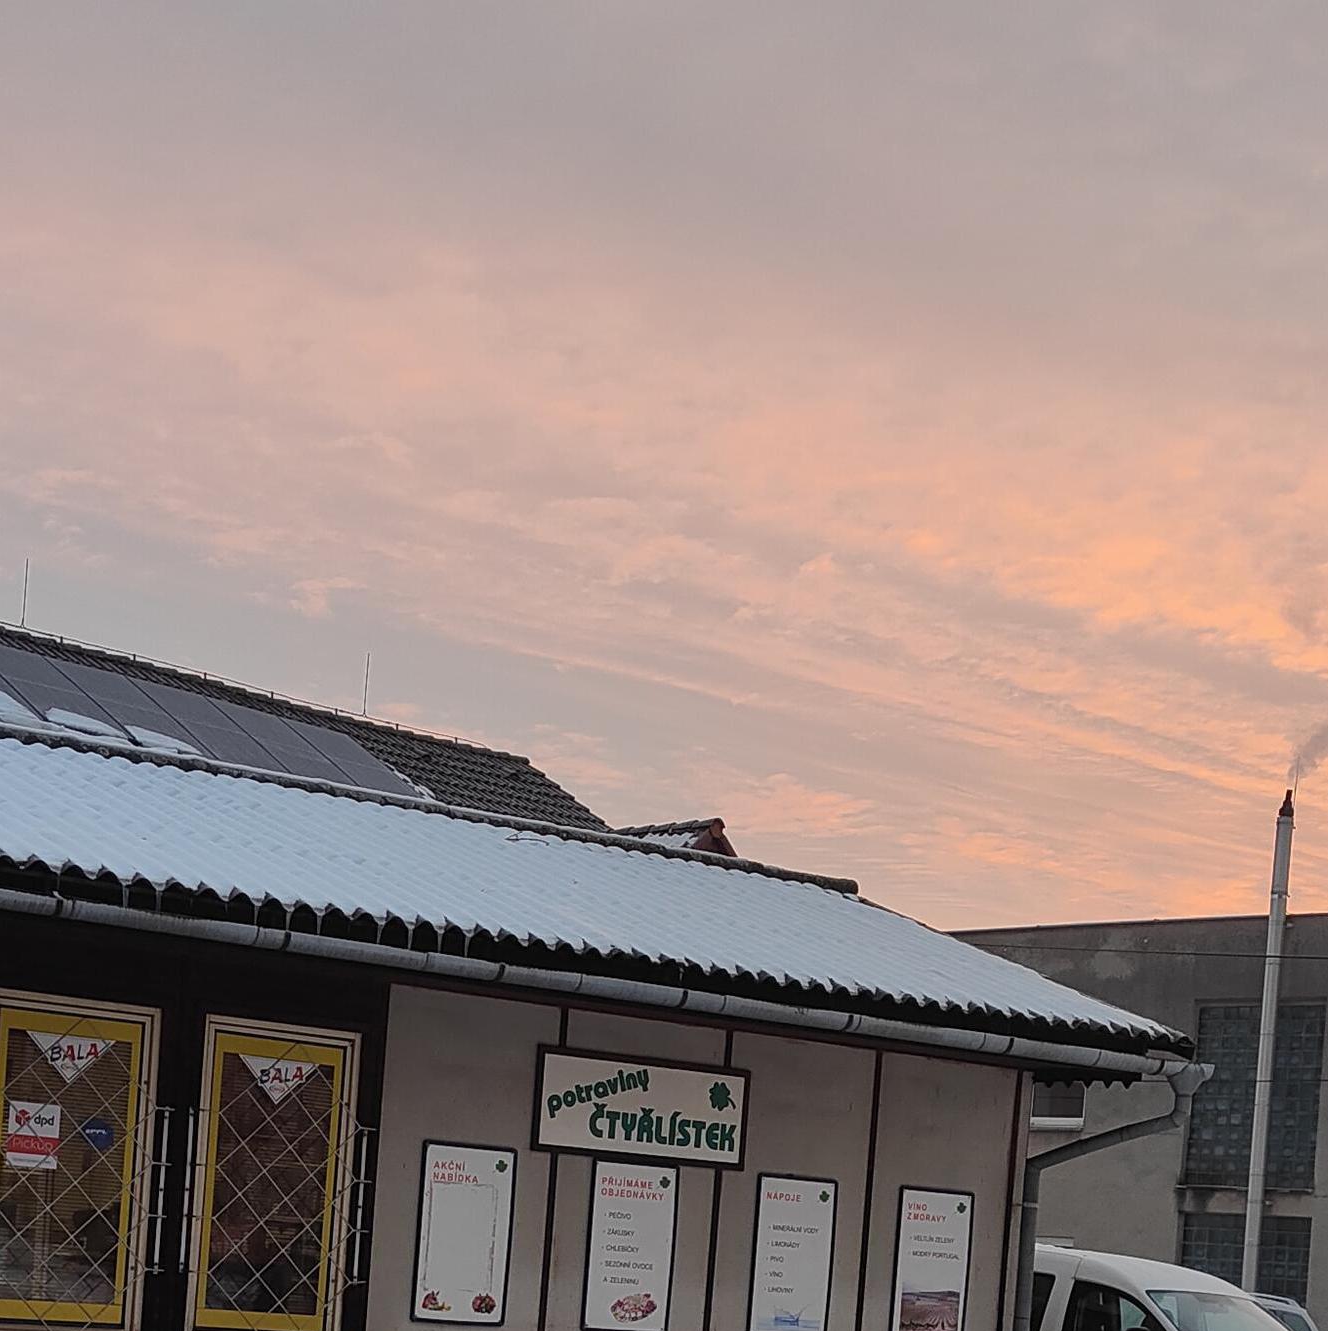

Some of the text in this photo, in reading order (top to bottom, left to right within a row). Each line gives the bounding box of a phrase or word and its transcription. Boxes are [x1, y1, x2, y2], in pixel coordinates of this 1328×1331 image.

[50, 1043, 99, 1062] BALA
[259, 1066, 304, 1084] BALA
[547, 1068, 650, 1118] potraviny
[33, 1115, 55, 1127] dpd
[589, 1102, 737, 1152] ČTYŘLÍSTEK
[433, 1171, 479, 1184] NABÍDKA
[601, 1176, 654, 1190] PŘIJÍMÁME
[601, 1187, 664, 1201] OBJEDNÁVKY
